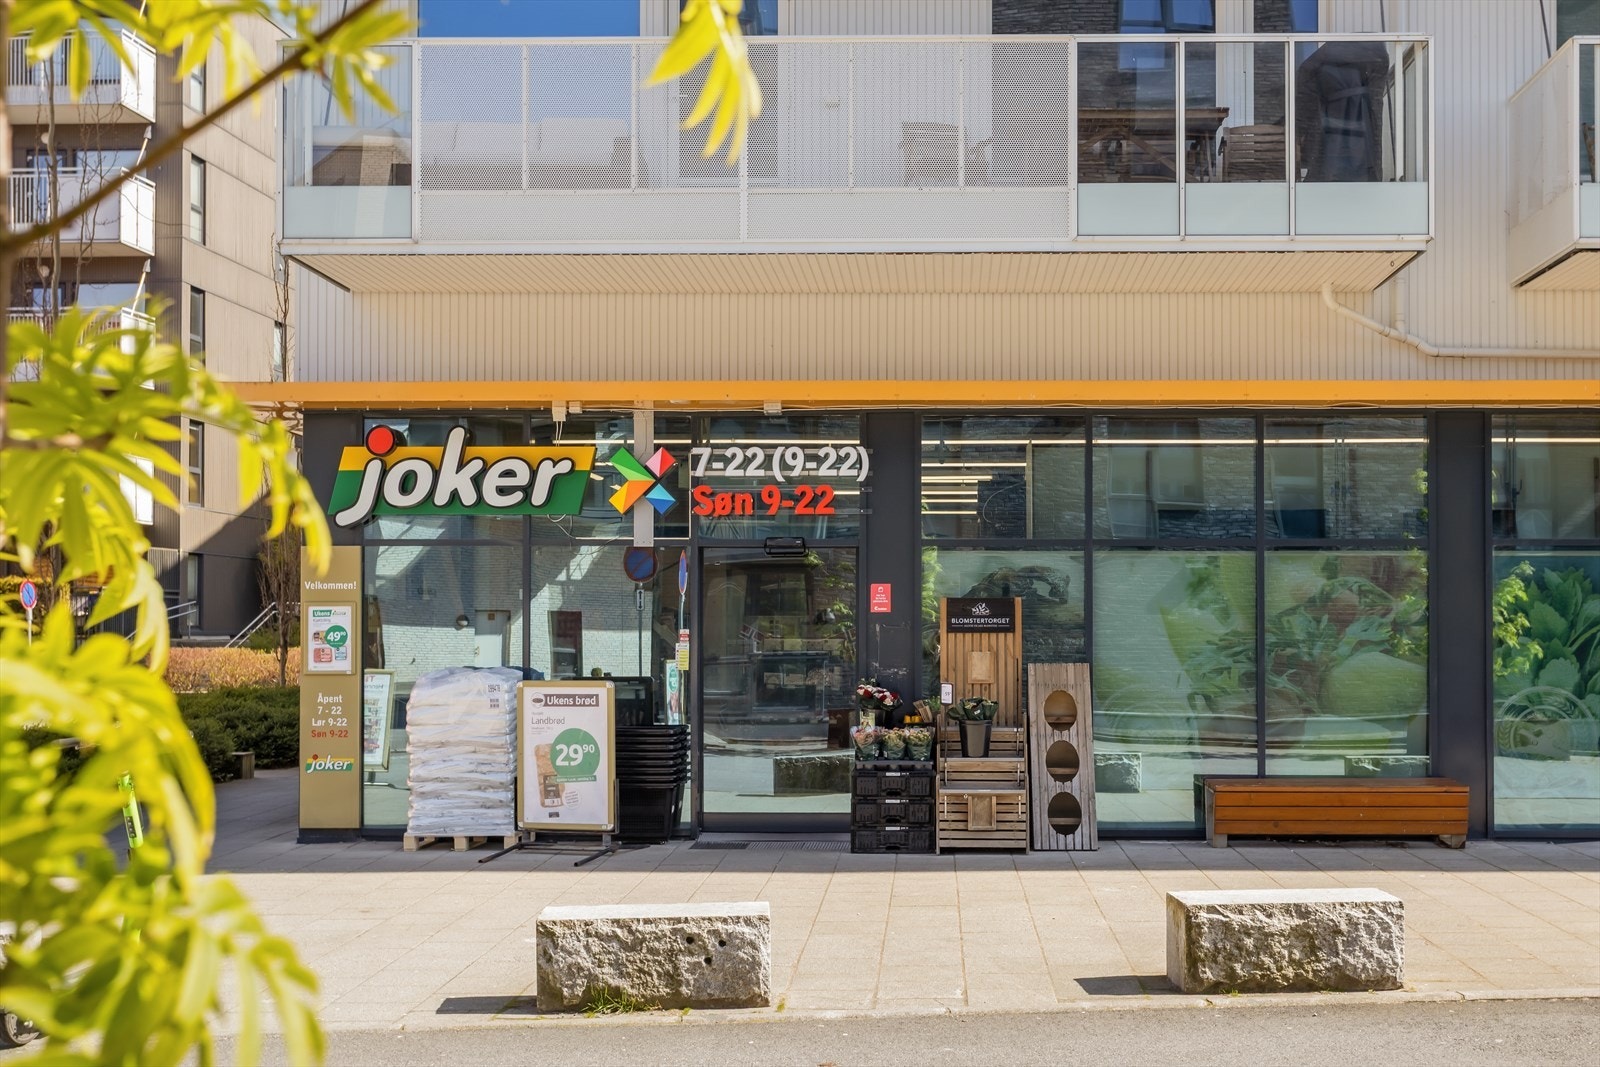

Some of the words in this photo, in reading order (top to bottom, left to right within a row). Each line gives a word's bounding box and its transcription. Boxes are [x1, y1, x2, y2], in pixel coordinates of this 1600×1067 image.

[691, 447, 765, 477] 7-22
[772, 446, 869, 482] (9-22)
[335, 425, 574, 526] joker
[692, 485, 753, 517] Søn
[761, 484, 835, 516] 9-22
[304, 581, 357, 590] Velkommen!
[317, 692, 343, 704] Åpent
[546, 695, 573, 705] Ukens
[575, 695, 596, 705] brød
[317, 706, 323, 715] 7
[331, 706, 342, 715] 22
[311, 718, 326, 727] Lør
[328, 718, 348, 727] 9-22
[531, 716, 566, 725] Landbrød
[311, 730, 327, 738] Søn
[329, 730, 349, 738] 9-22
[307, 754, 351, 774] joker
